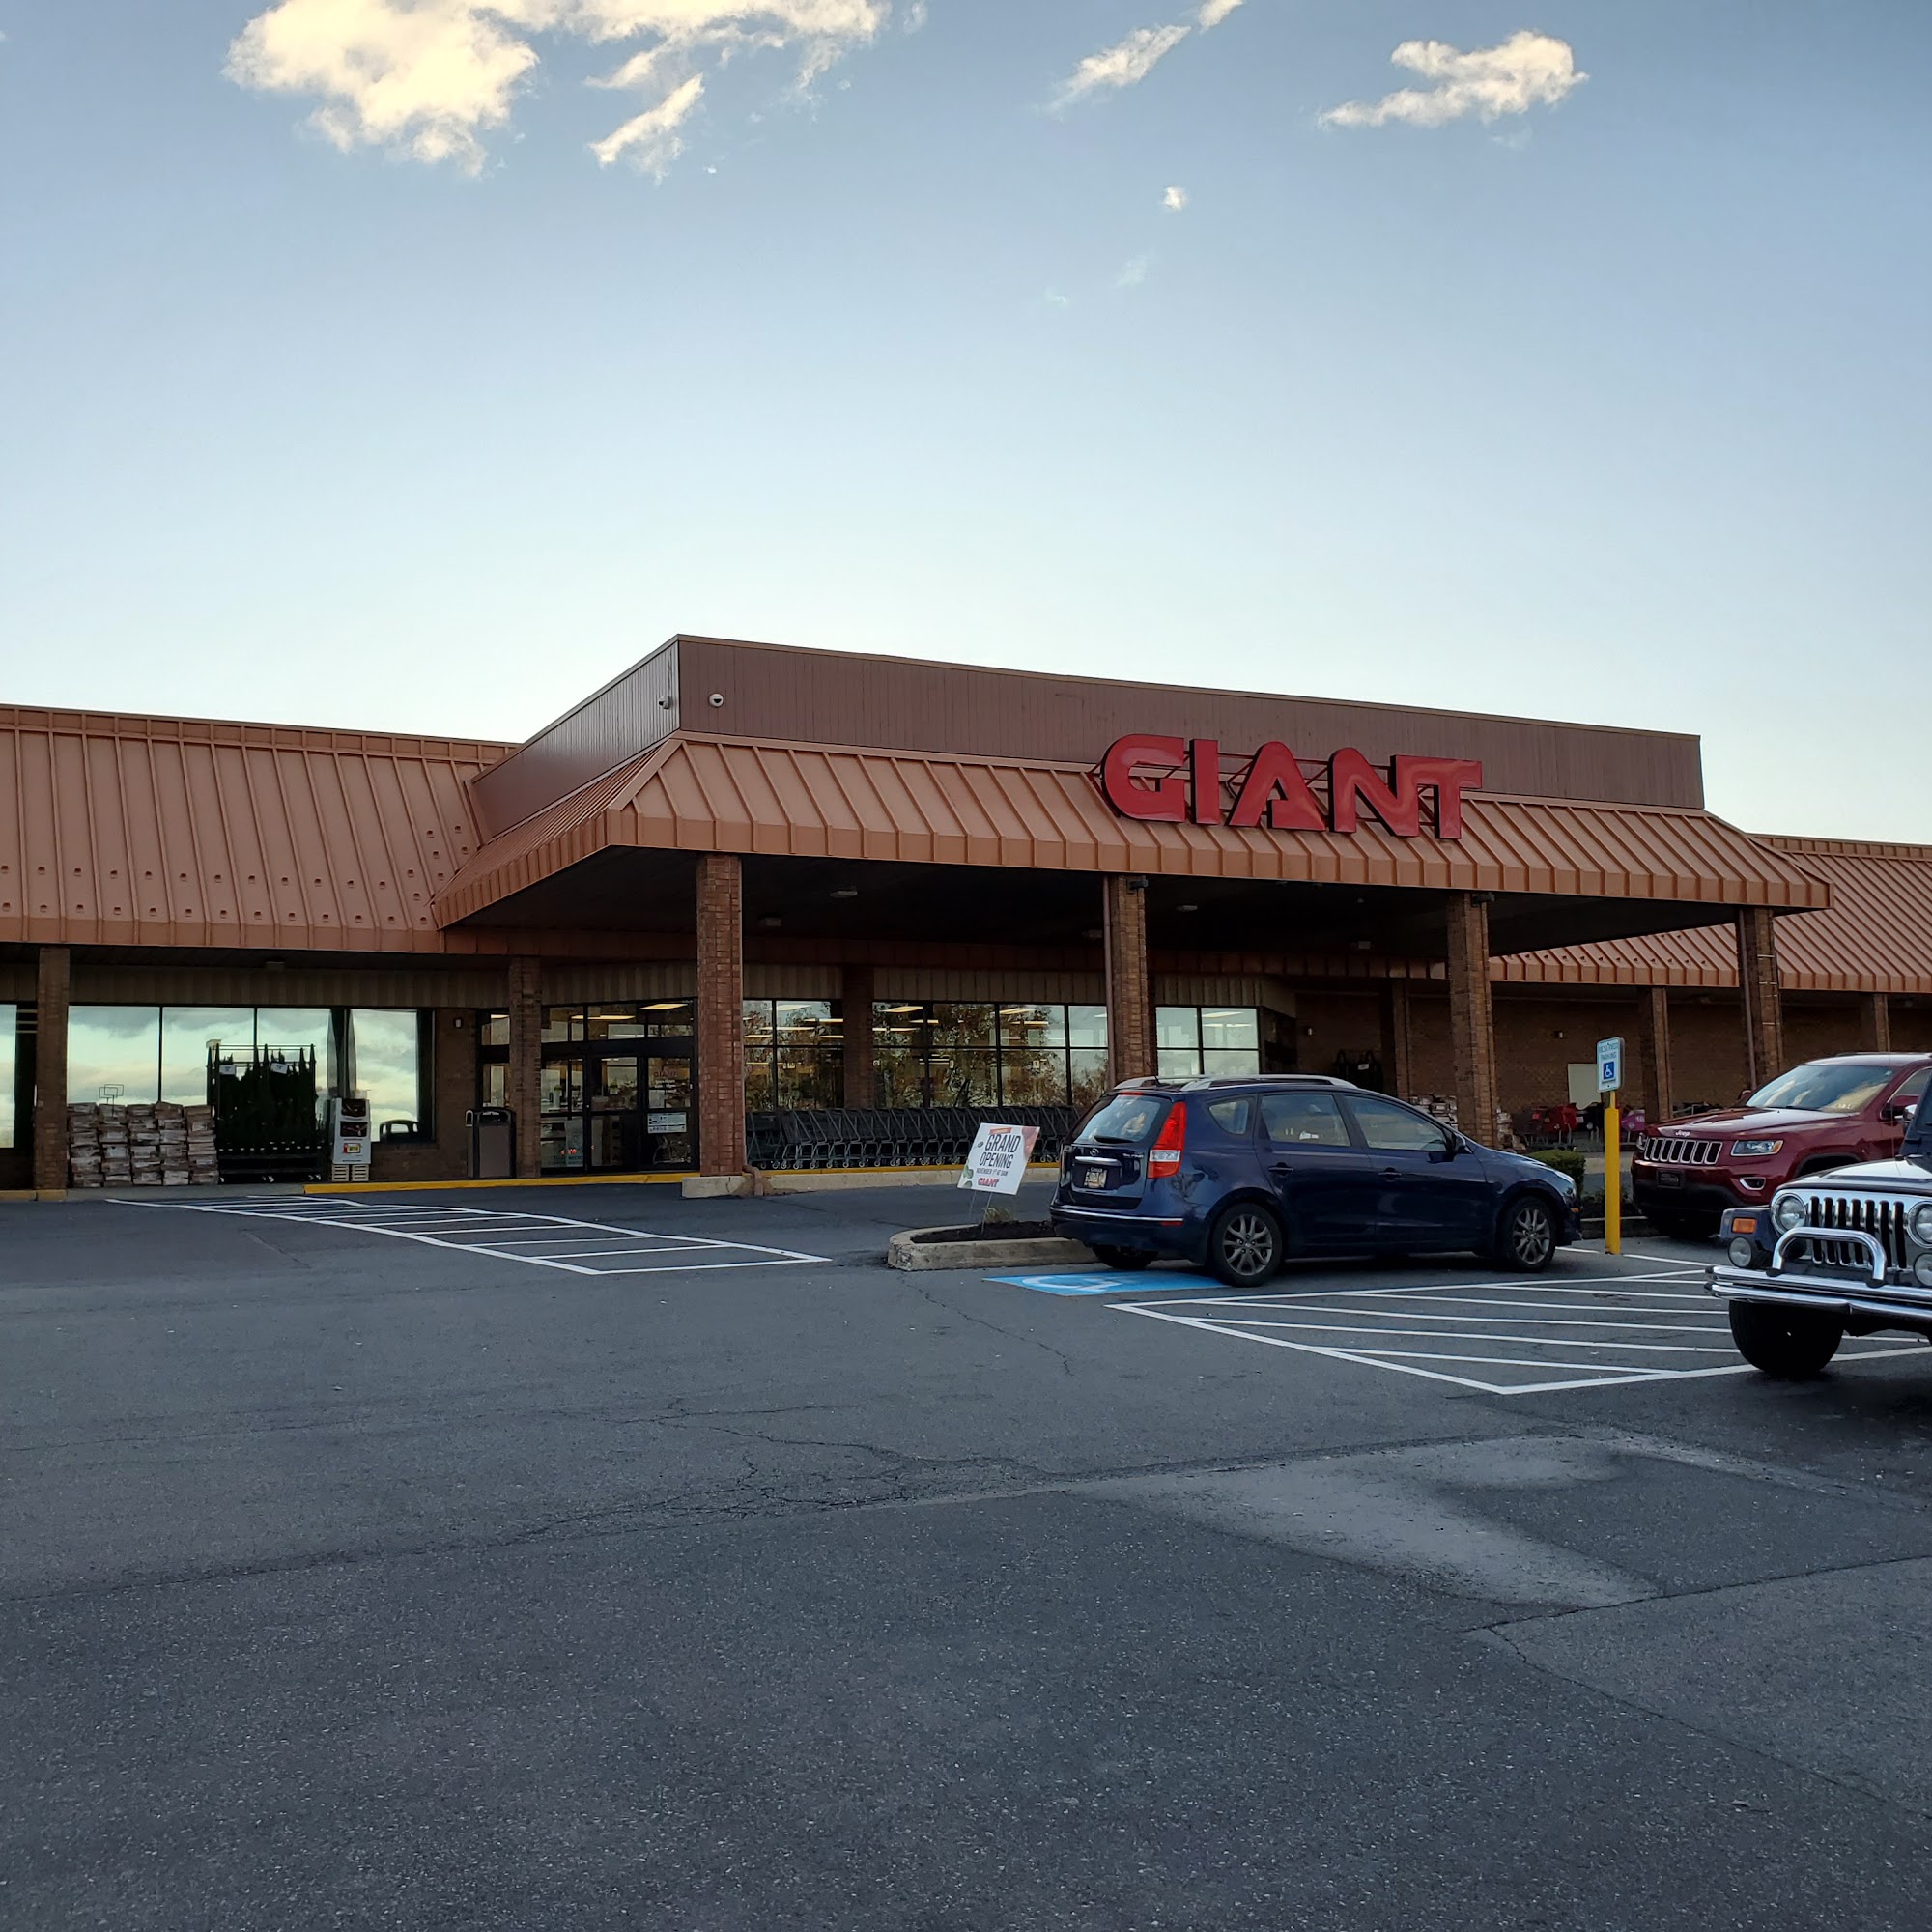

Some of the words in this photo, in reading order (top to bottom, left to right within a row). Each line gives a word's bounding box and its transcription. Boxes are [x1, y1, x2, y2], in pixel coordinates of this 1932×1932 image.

[1100, 733, 1483, 840] GIANT
[984, 1133, 1021, 1153] GRAND
[979, 1151, 1014, 1169] OPENING
[978, 1177, 1000, 1188] GIANT
